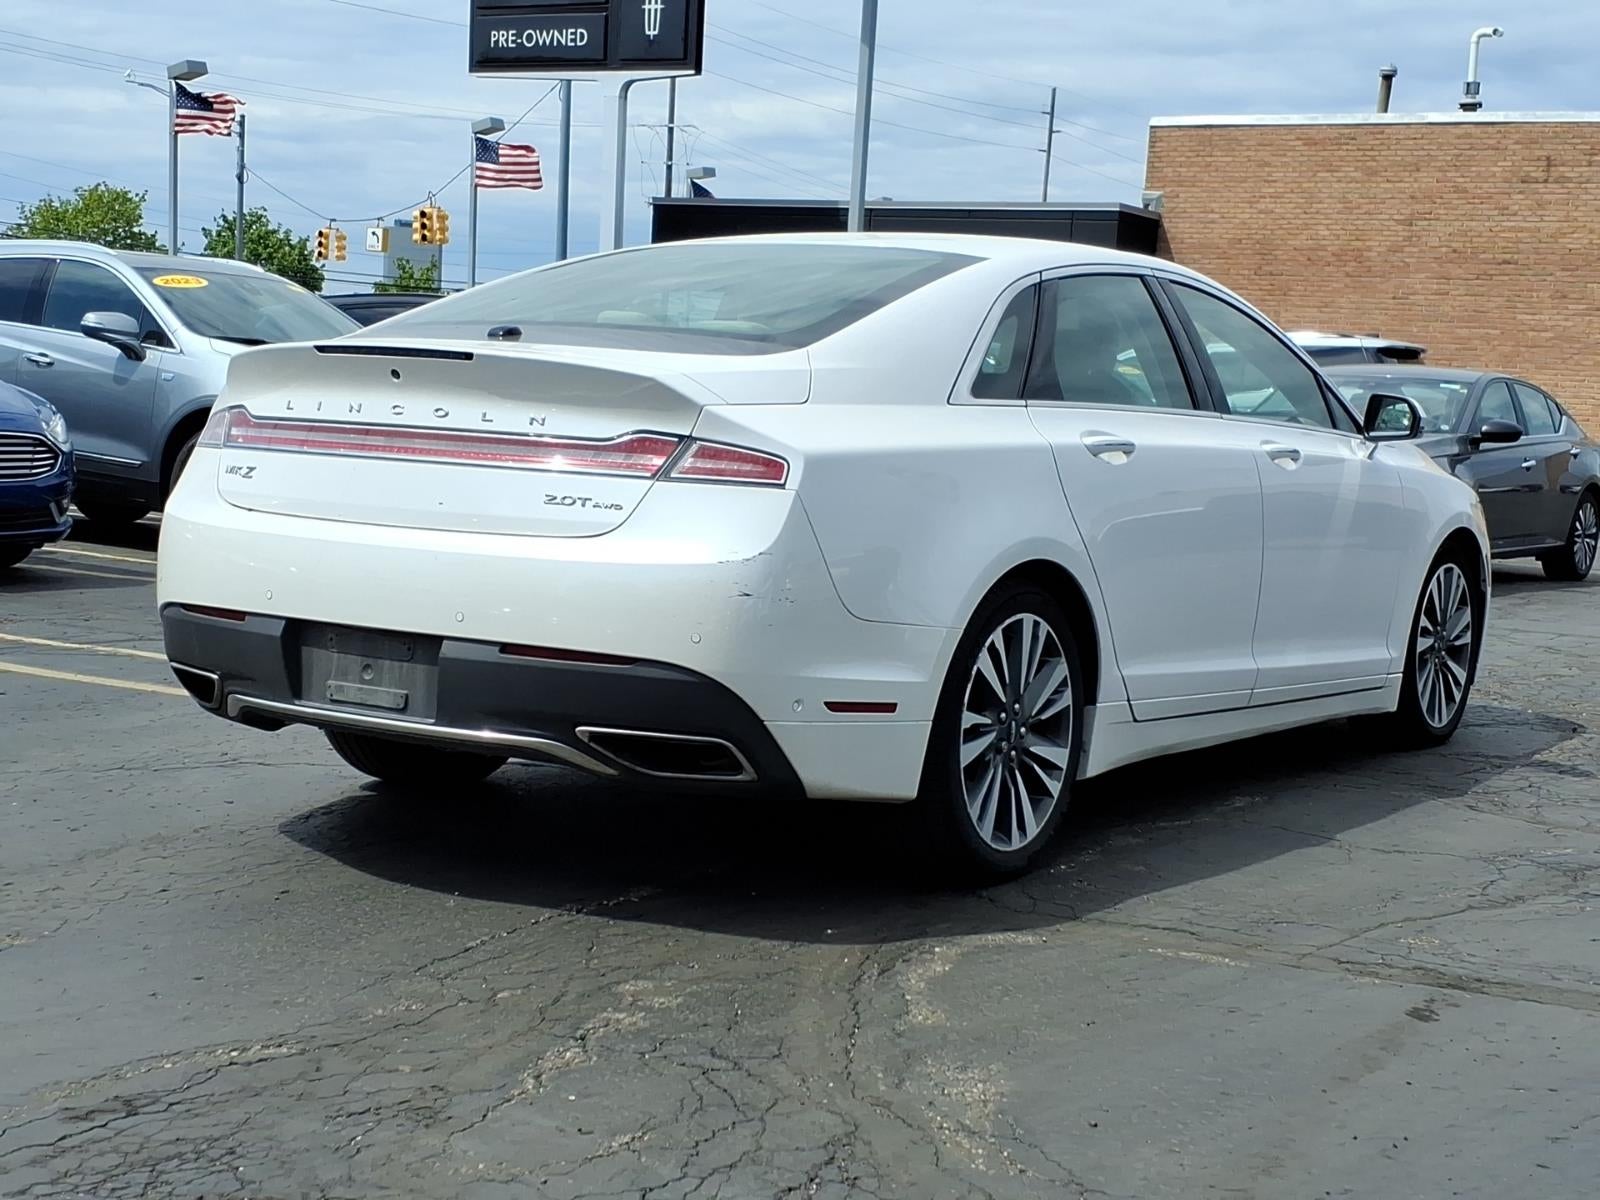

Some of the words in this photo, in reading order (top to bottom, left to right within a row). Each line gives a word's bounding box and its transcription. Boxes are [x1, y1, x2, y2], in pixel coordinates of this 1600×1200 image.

[490, 29, 588, 48] PRE-OWNED
[285, 399, 547, 427] LINCOLN
[225, 465, 257, 479] MKZ
